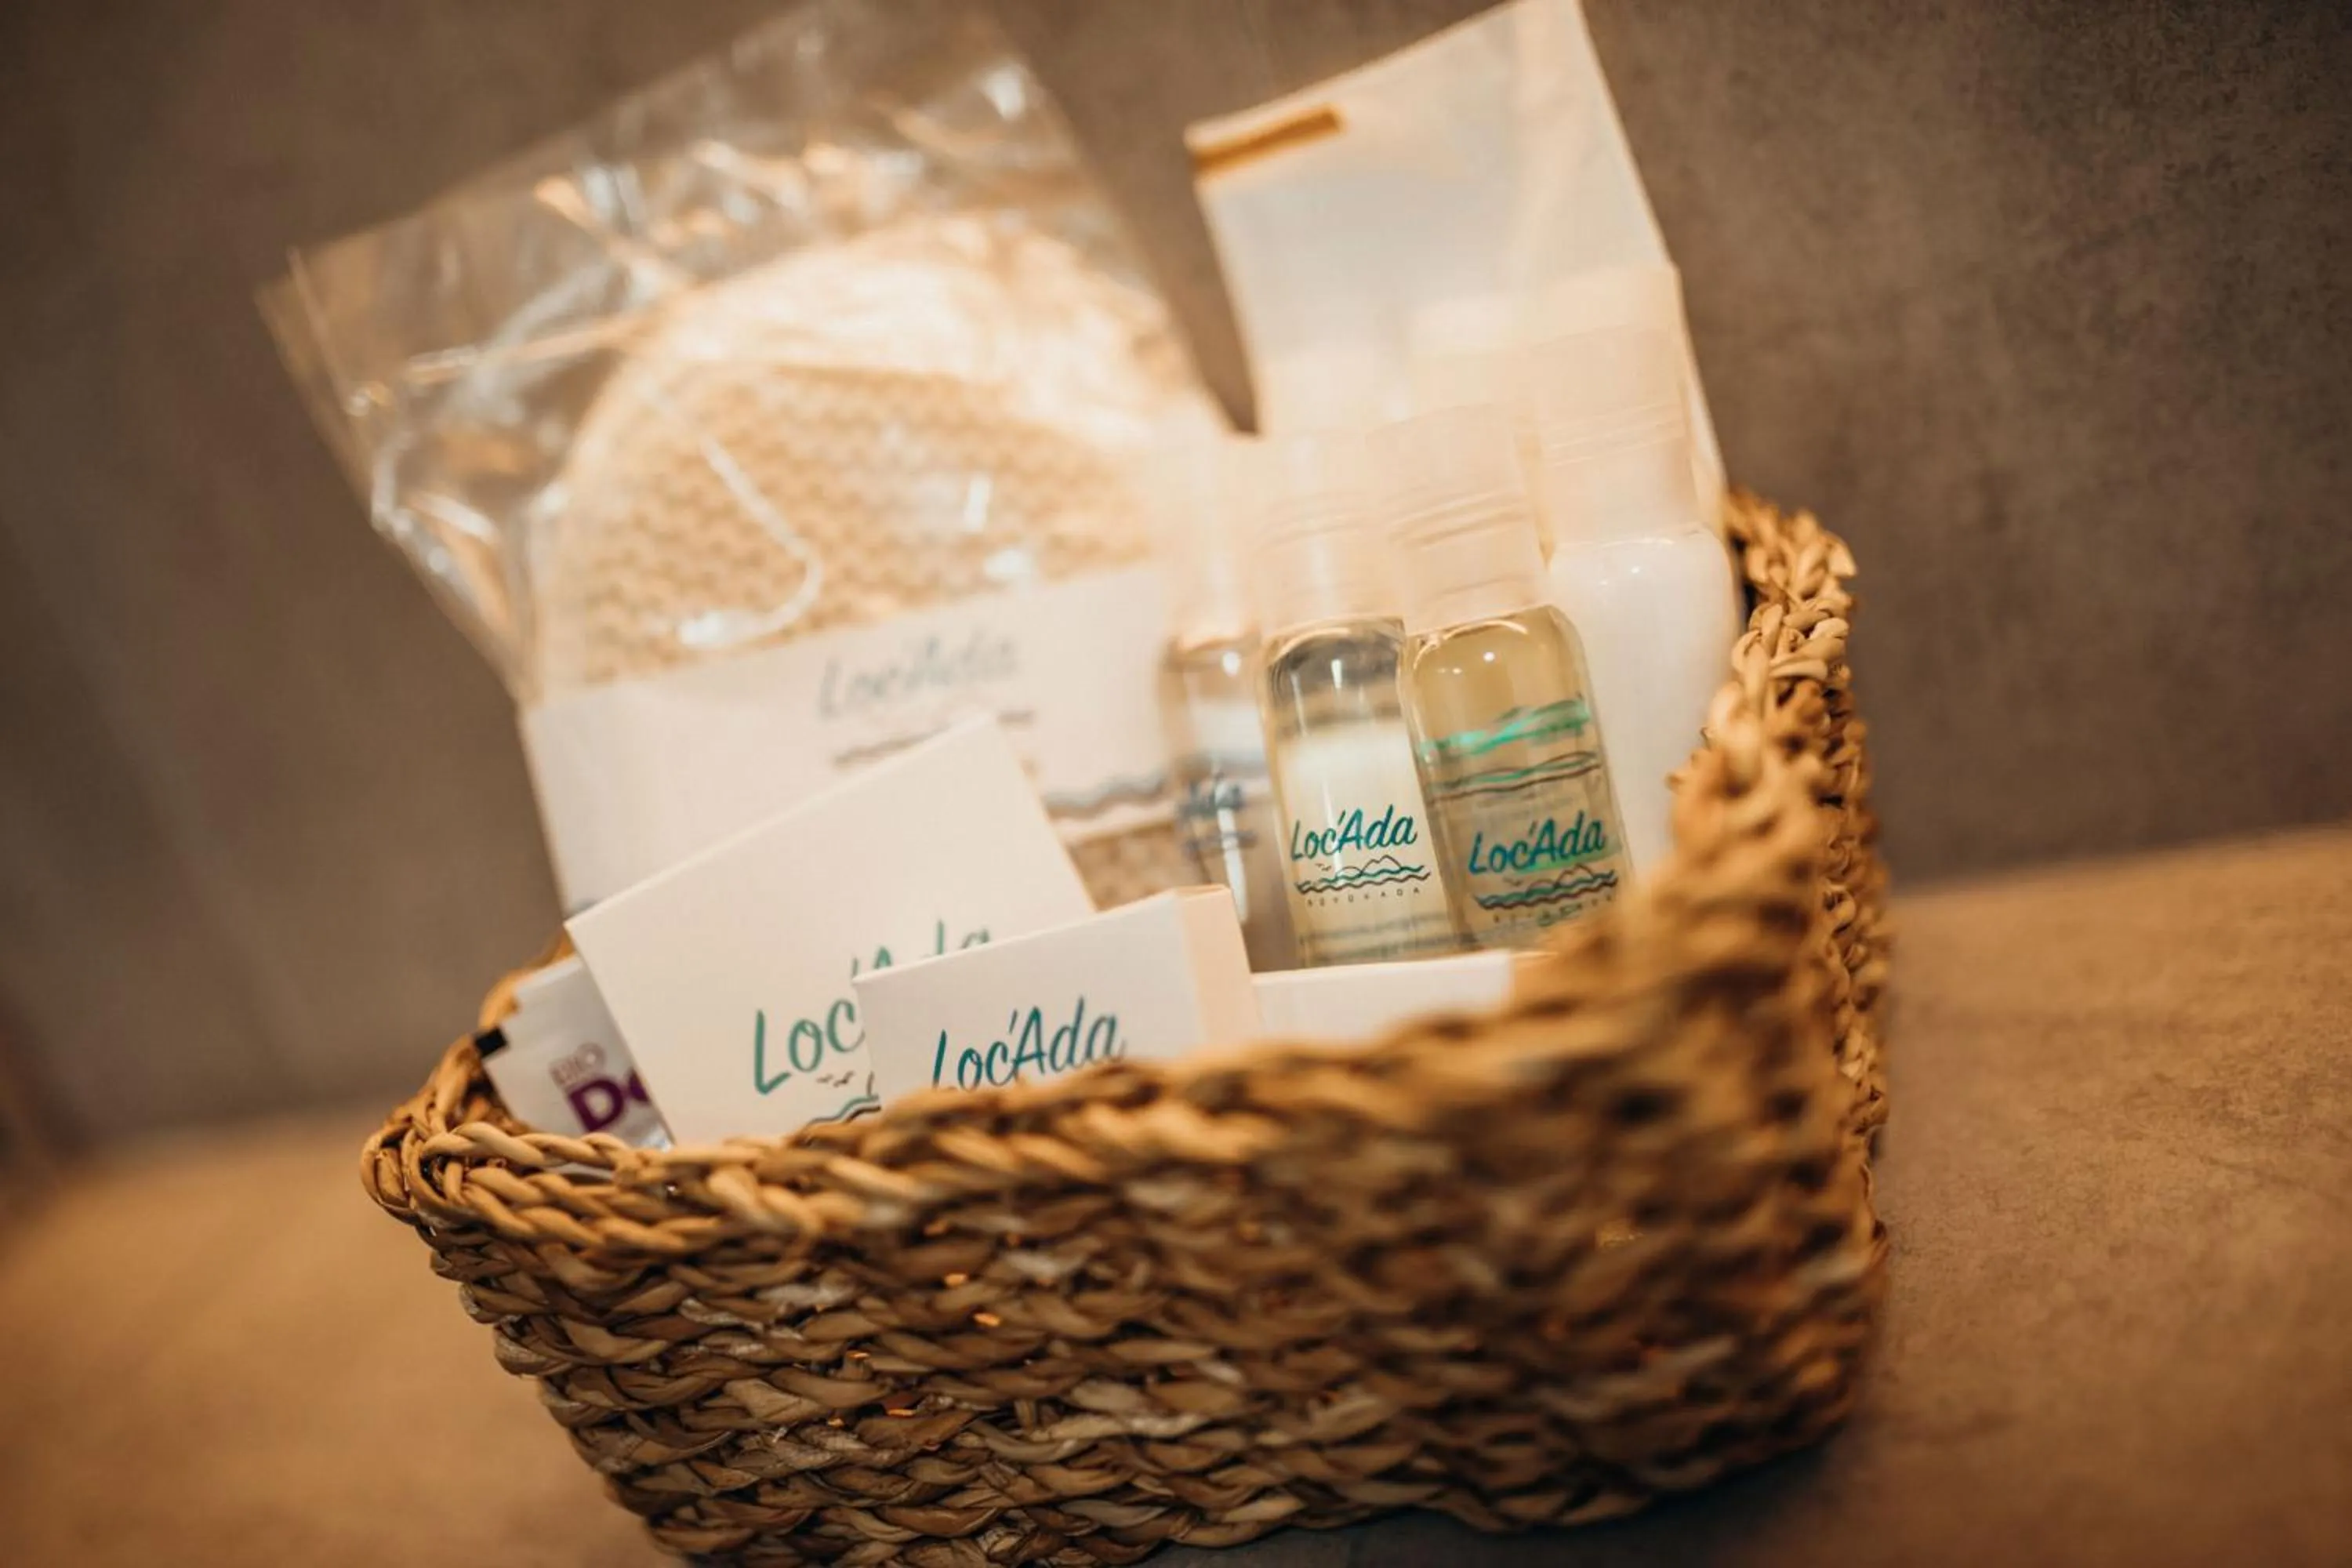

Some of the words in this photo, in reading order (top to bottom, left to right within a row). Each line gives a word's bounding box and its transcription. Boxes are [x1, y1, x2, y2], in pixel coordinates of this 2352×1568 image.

[1290, 804, 1417, 862] Loc'Ada
[1468, 809, 1607, 874] Loc'Ada
[931, 995, 1127, 1091] Loc'Ada
